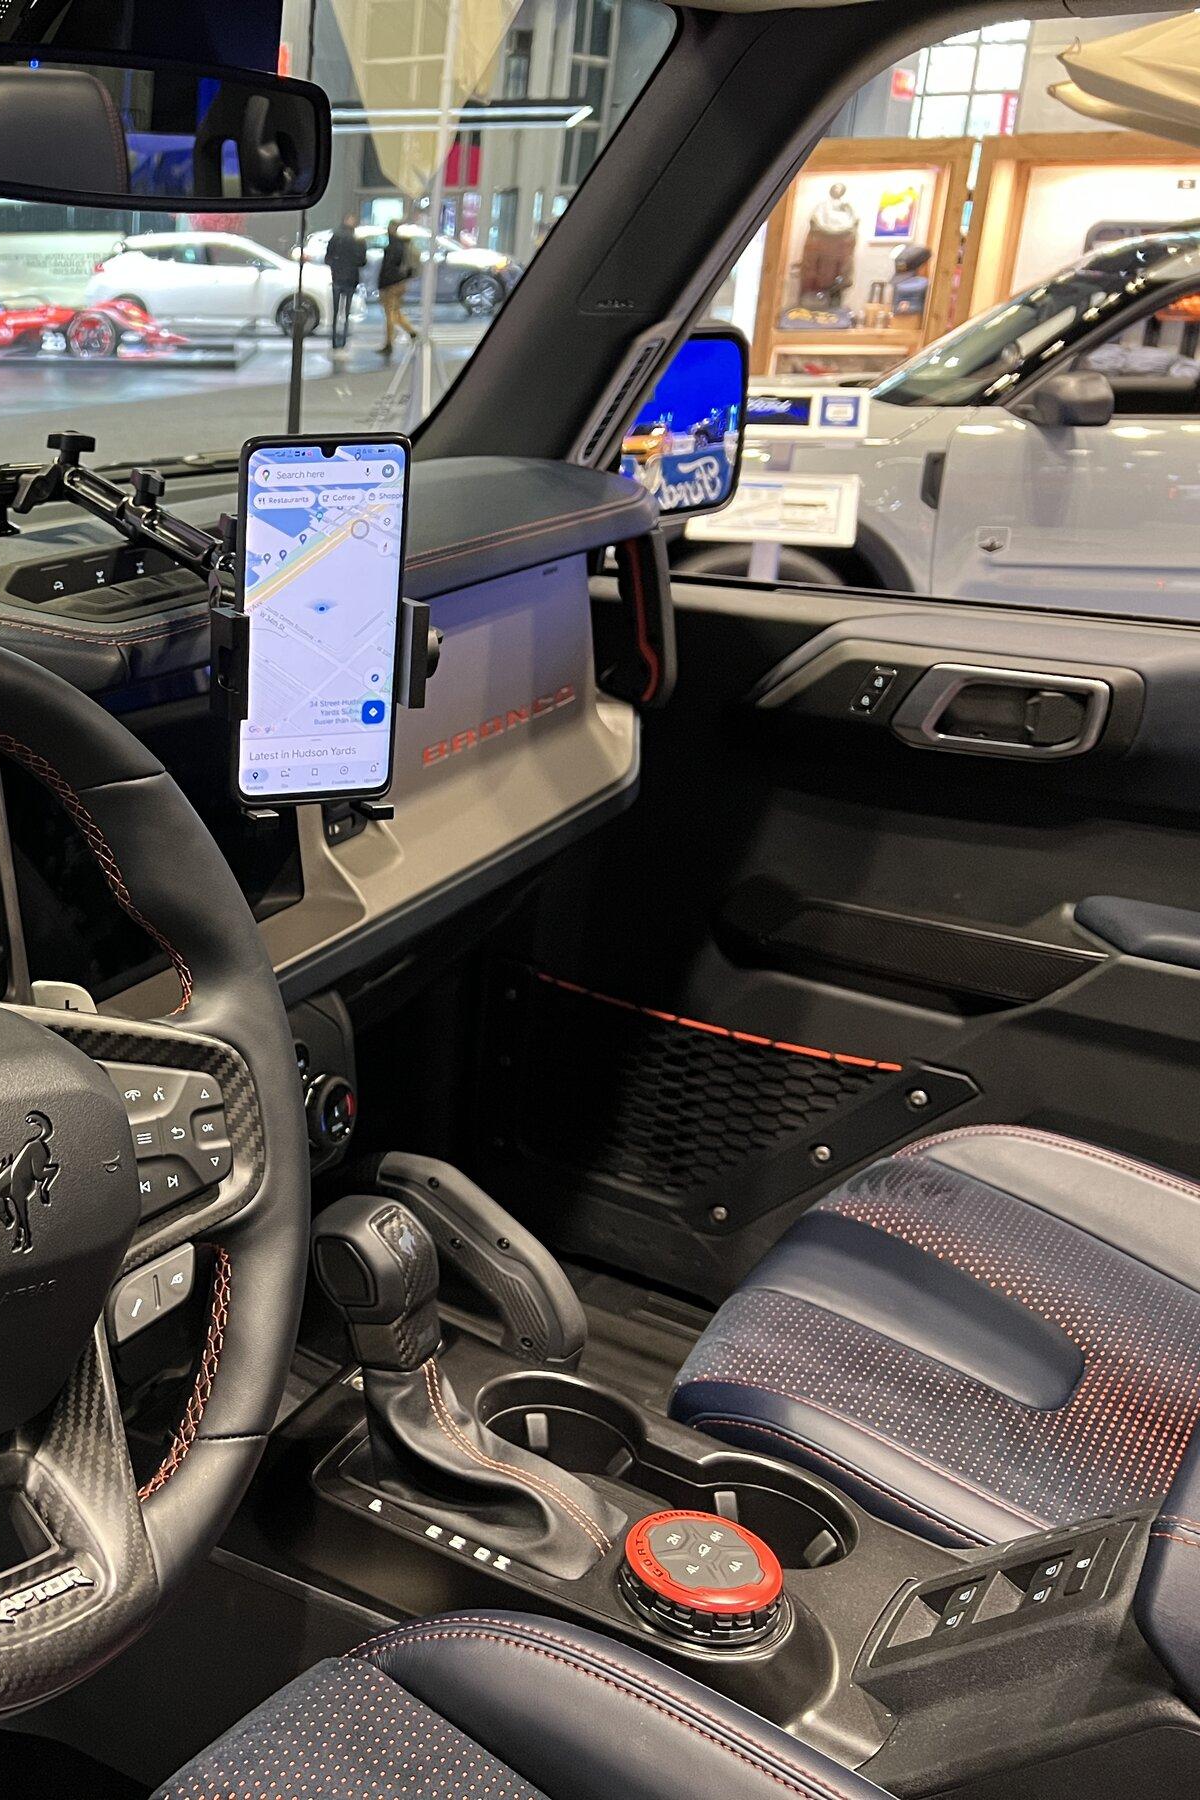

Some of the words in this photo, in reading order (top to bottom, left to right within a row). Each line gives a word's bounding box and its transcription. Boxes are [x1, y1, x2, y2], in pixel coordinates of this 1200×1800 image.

[276, 470, 305, 480] Search
[306, 469, 325, 479] here
[268, 495, 309, 504] Restaurants
[332, 493, 356, 502] Coffee
[421, 681, 576, 768] BRONCO
[249, 751, 279, 761] Latest
[280, 751, 290, 760] in
[291, 748, 328, 759] Hudson
[330, 745, 357, 757] Yards
[201, 1123, 215, 1133] OK
[685, 1564, 700, 1575] 4L
